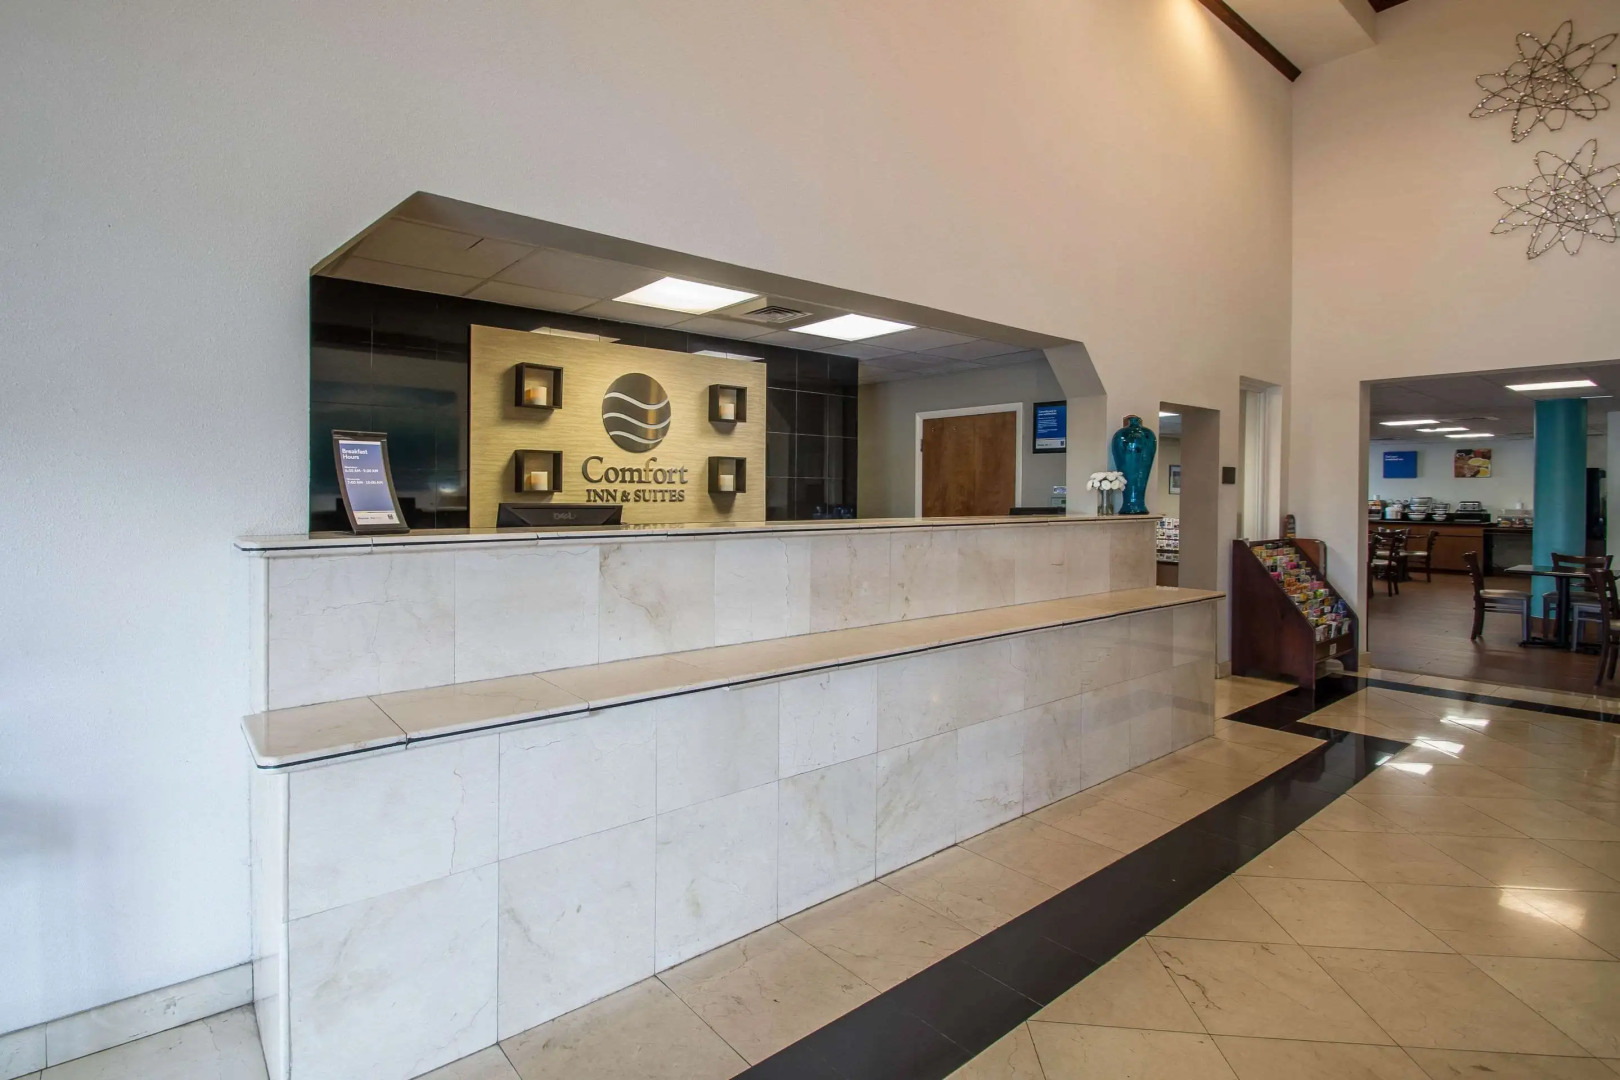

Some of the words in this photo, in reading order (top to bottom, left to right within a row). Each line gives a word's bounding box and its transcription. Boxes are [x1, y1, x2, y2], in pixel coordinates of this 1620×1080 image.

[582, 456, 688, 484] Comfort
[585, 489, 618, 502] INN
[620, 490, 631, 502] &
[633, 489, 685, 502] SUITES
